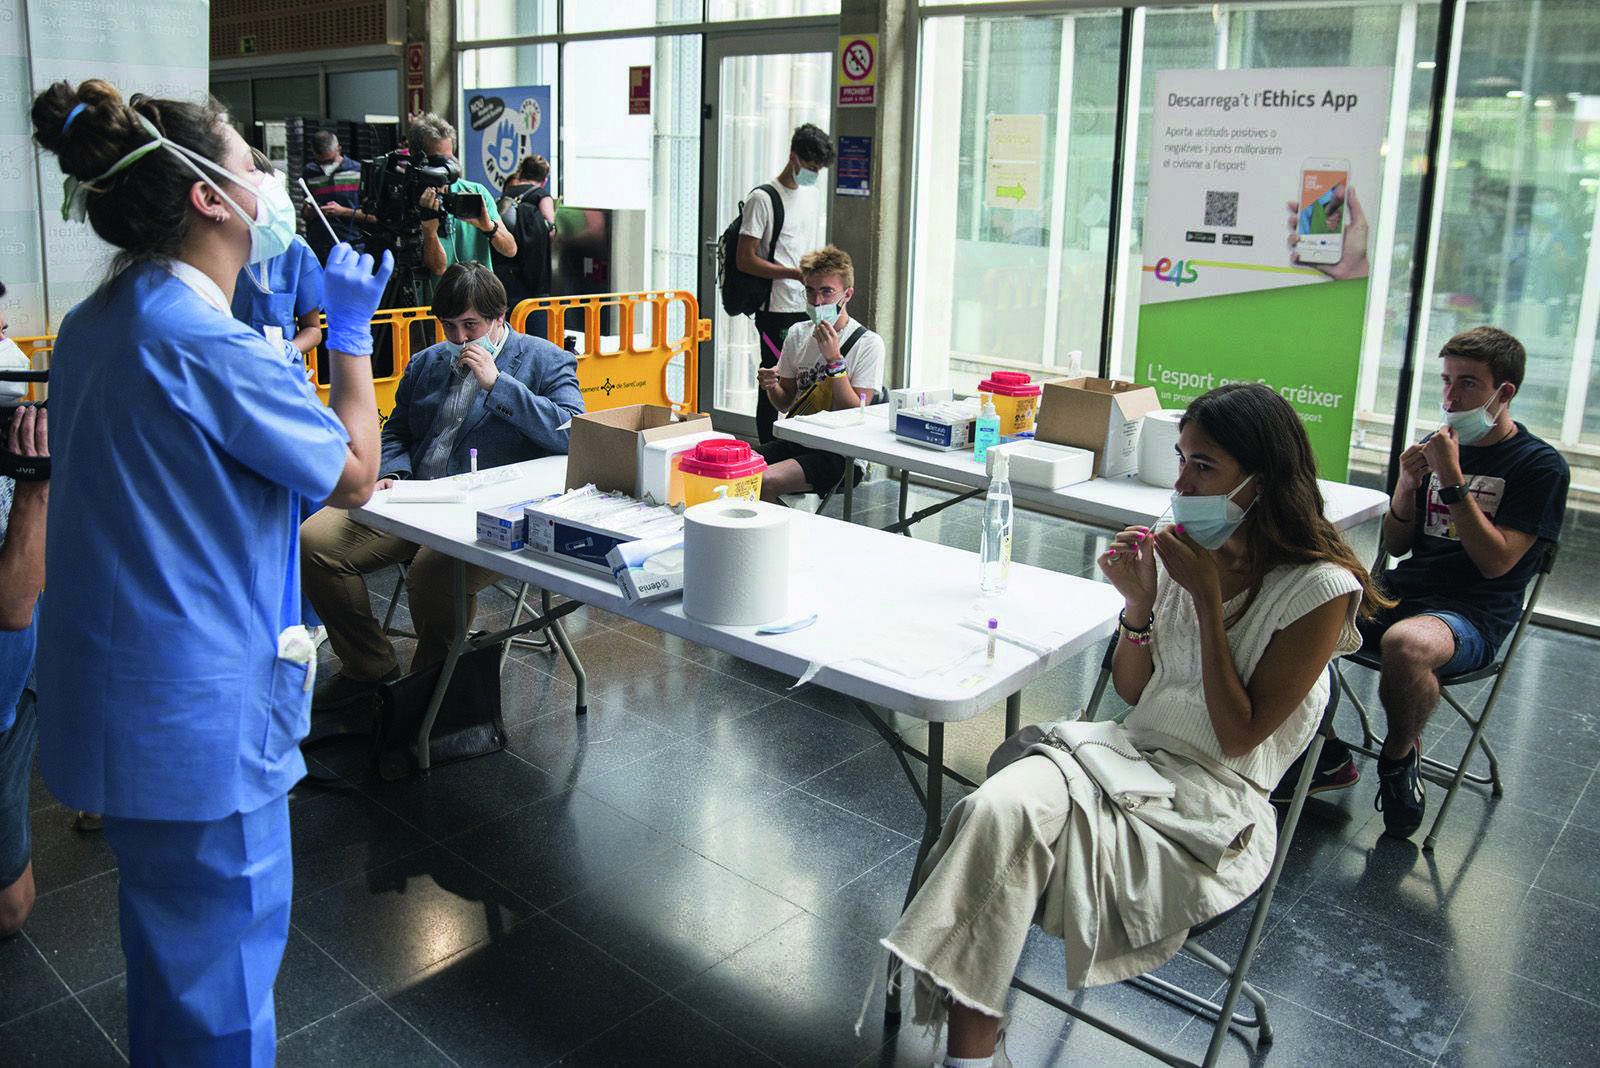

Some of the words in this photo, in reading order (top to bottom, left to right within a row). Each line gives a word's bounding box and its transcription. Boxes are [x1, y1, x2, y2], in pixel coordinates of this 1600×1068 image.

[1168, 92, 1251, 112] Descarrega't
[1254, 89, 1315, 108] l'Ethics
[1322, 89, 1358, 112] App
[1165, 126, 1193, 139] Aporta
[1230, 128, 1268, 140] positives
[1164, 142, 1202, 155] negatives
[1209, 143, 1232, 155] junts
[1172, 160, 1203, 170] civisme
[1147, 363, 1215, 390] L'esport
[1280, 383, 1343, 409] créixer
[1161, 391, 1171, 400] un
